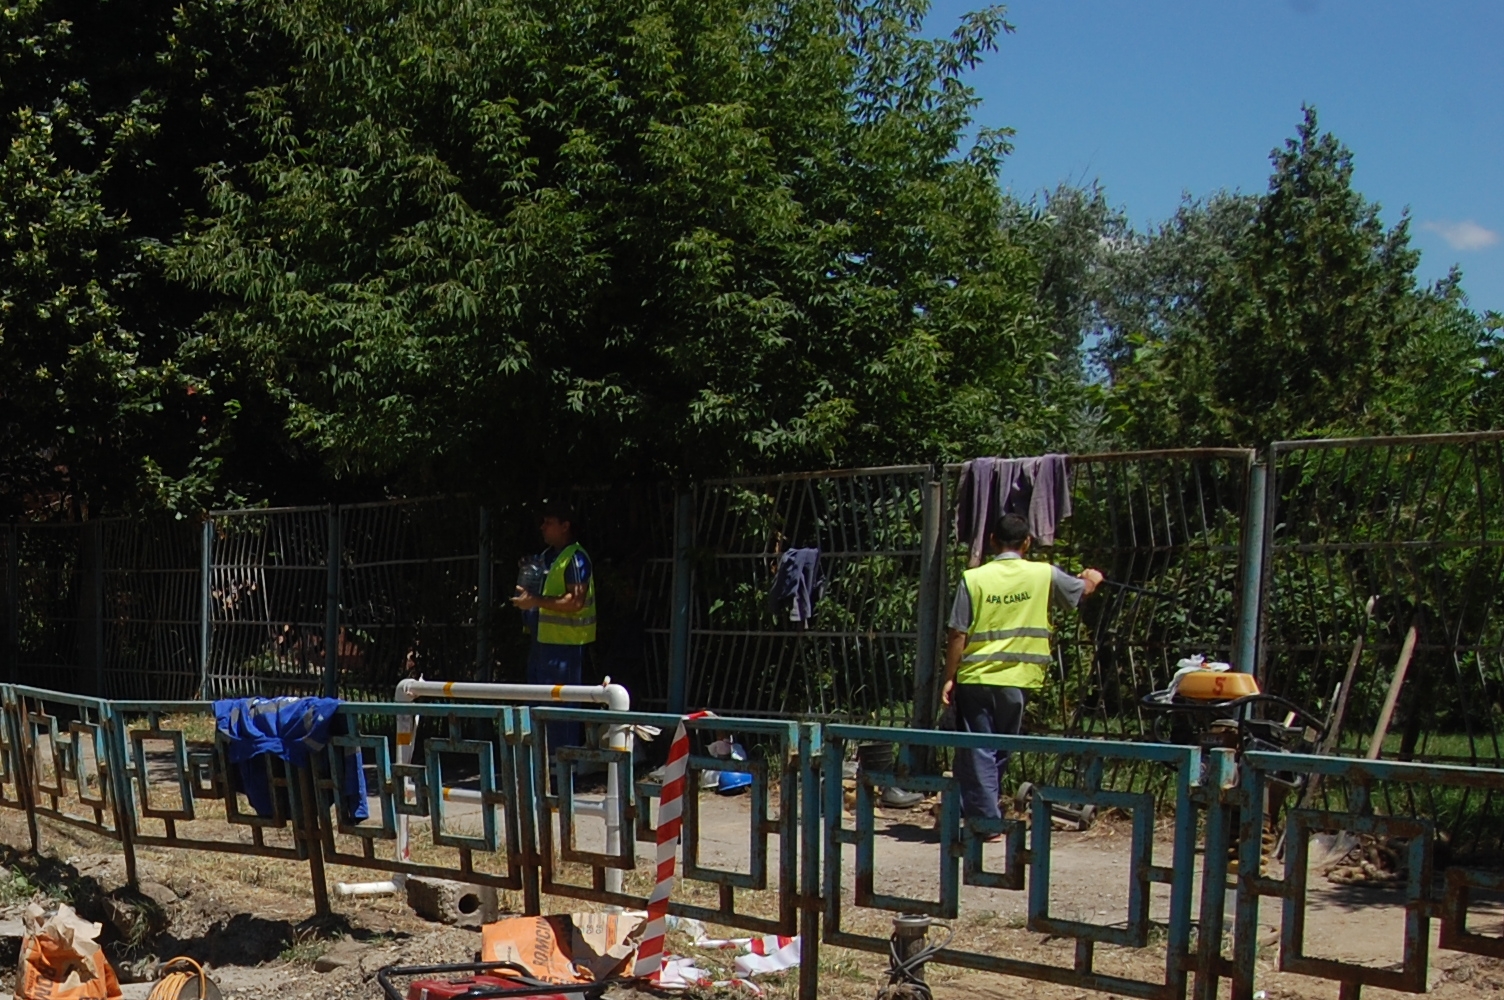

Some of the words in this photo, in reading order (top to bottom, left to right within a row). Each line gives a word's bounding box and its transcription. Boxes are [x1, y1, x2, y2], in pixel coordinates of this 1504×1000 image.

[986, 594, 1002, 604] APA
[1004, 591, 1031, 604] CANAL
[1212, 676, 1227, 696] 5
